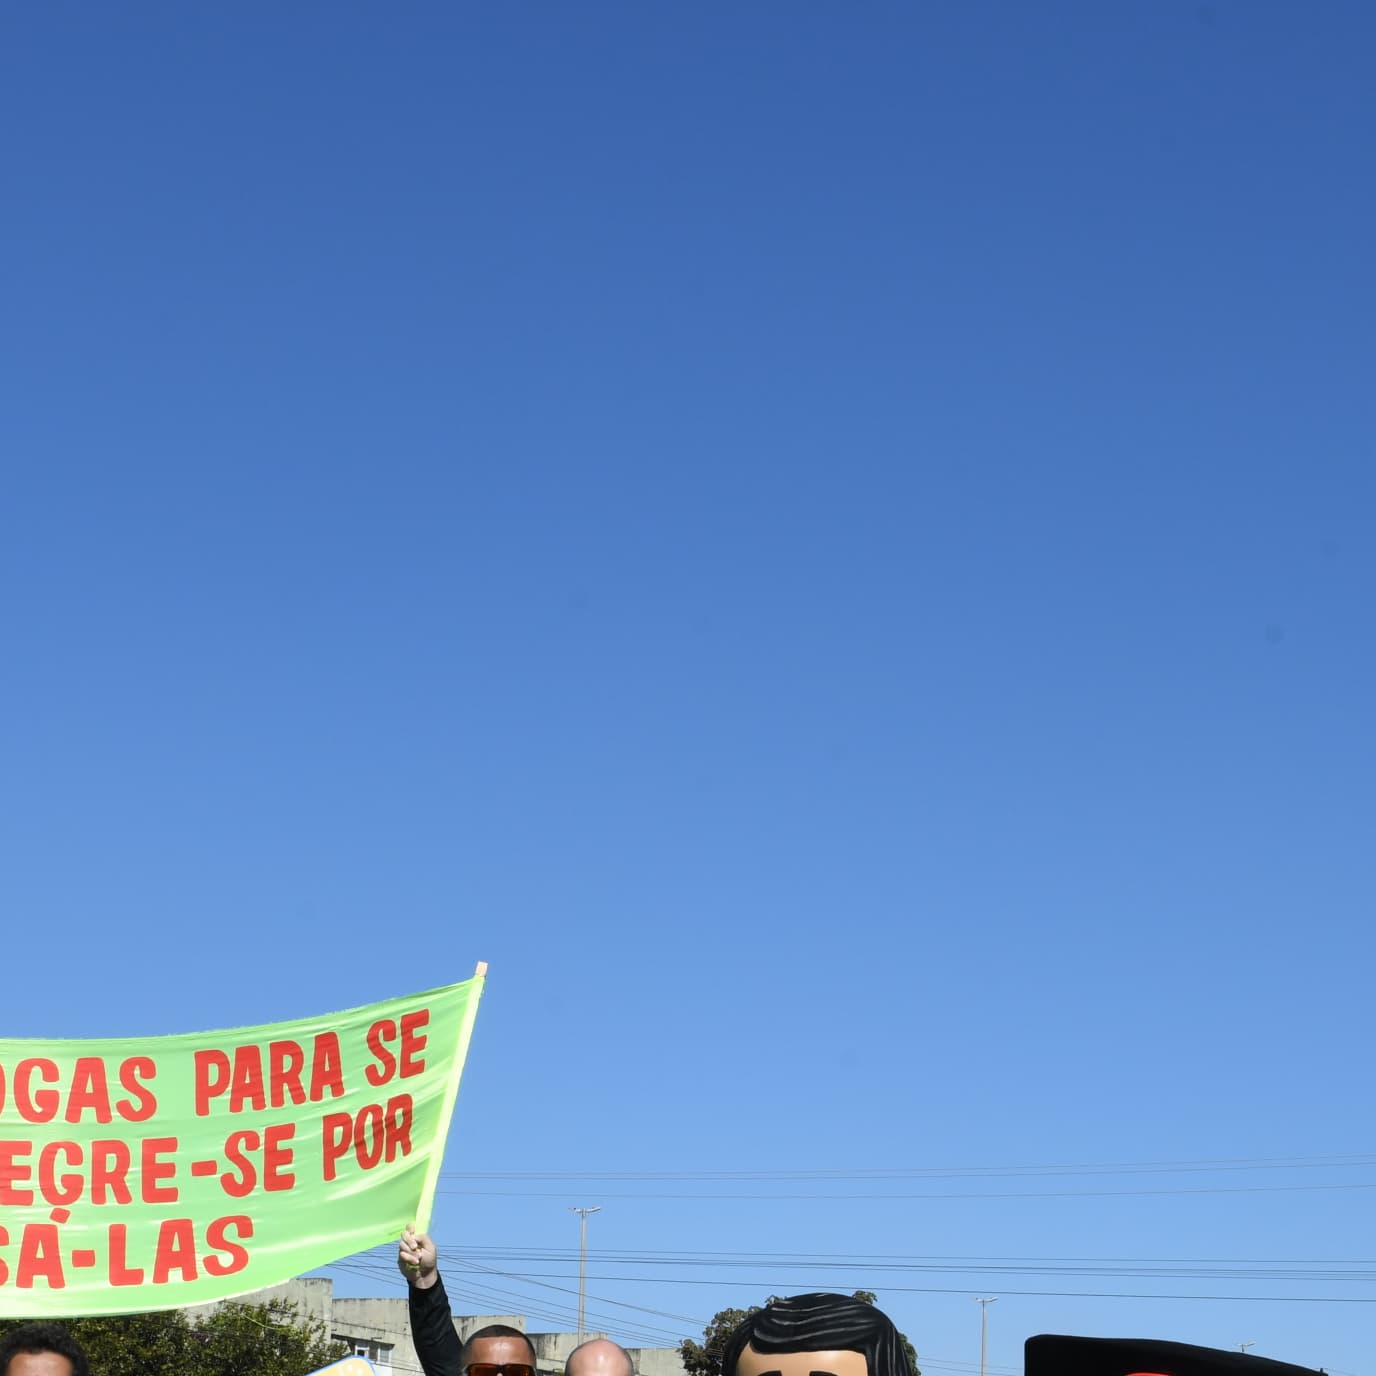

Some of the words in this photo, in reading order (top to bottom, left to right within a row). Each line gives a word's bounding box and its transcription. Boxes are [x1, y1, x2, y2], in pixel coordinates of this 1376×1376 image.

[194, 1032, 345, 1117] PARA
[365, 1009, 430, 1087] SE
[323, 1094, 413, 1181] POR
